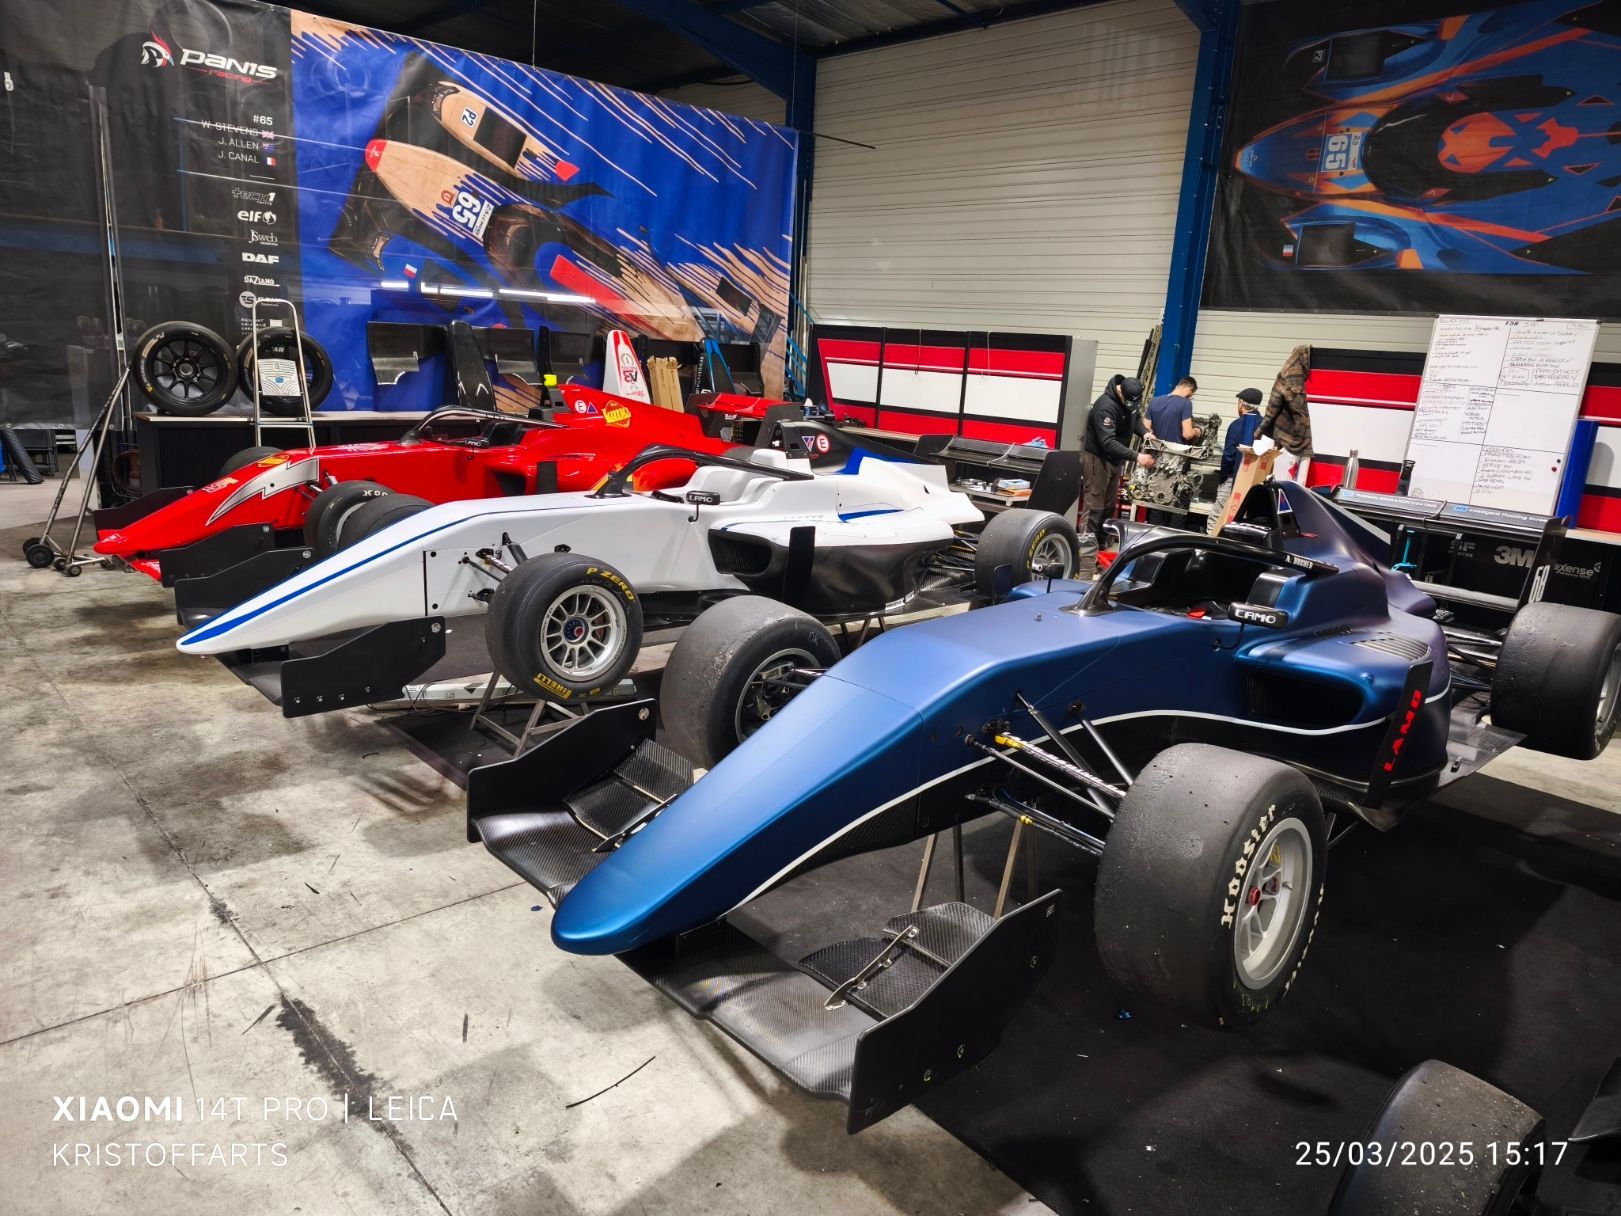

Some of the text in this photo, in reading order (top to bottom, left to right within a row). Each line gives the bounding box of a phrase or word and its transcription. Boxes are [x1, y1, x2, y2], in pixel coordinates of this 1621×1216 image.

[253, 114, 274, 126] #65
[461, 108, 477, 128] P2
[218, 136, 260, 151] J. ALLEN
[1325, 135, 1349, 169] 65
[217, 150, 260, 164] J. CANAL
[452, 191, 482, 229] 65
[242, 252, 280, 264] DAF
[1494, 545, 1536, 569] 3M
[586, 567, 635, 600] P ZERO
